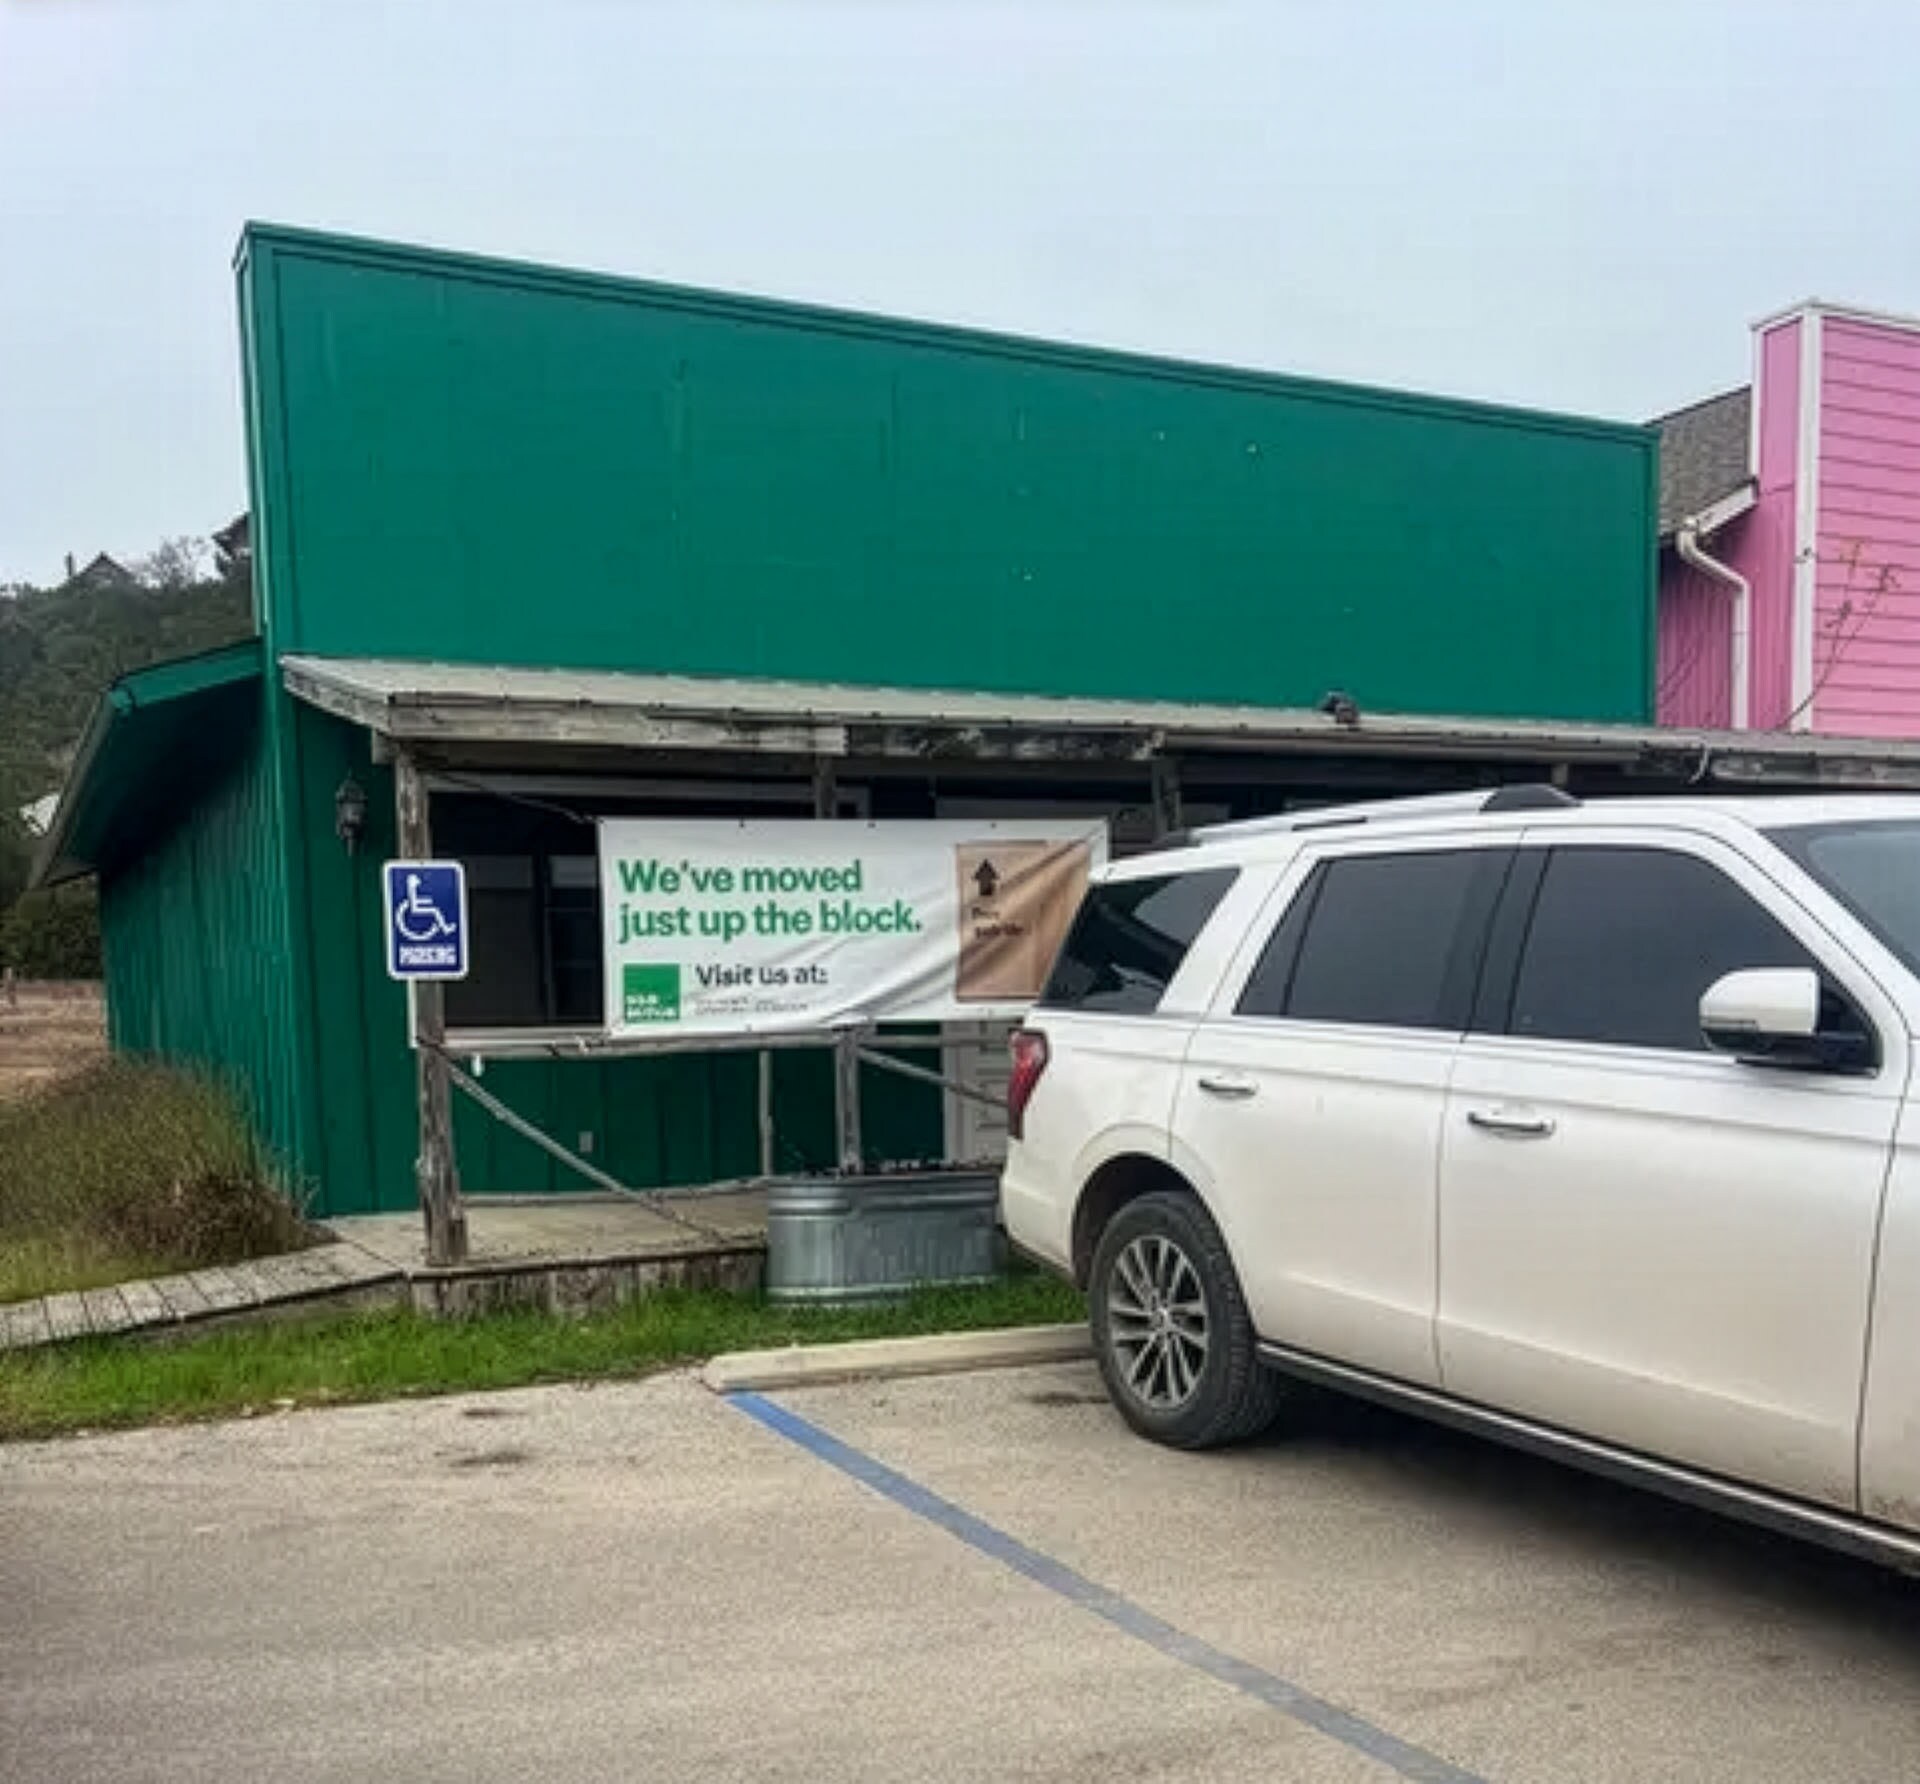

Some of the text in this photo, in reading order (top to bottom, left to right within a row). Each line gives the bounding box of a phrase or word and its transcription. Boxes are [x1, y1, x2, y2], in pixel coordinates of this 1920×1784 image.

[618, 859, 862, 893] We've moved
[619, 900, 922, 944] just up the block.
[696, 965, 828, 987] Visit us at:
